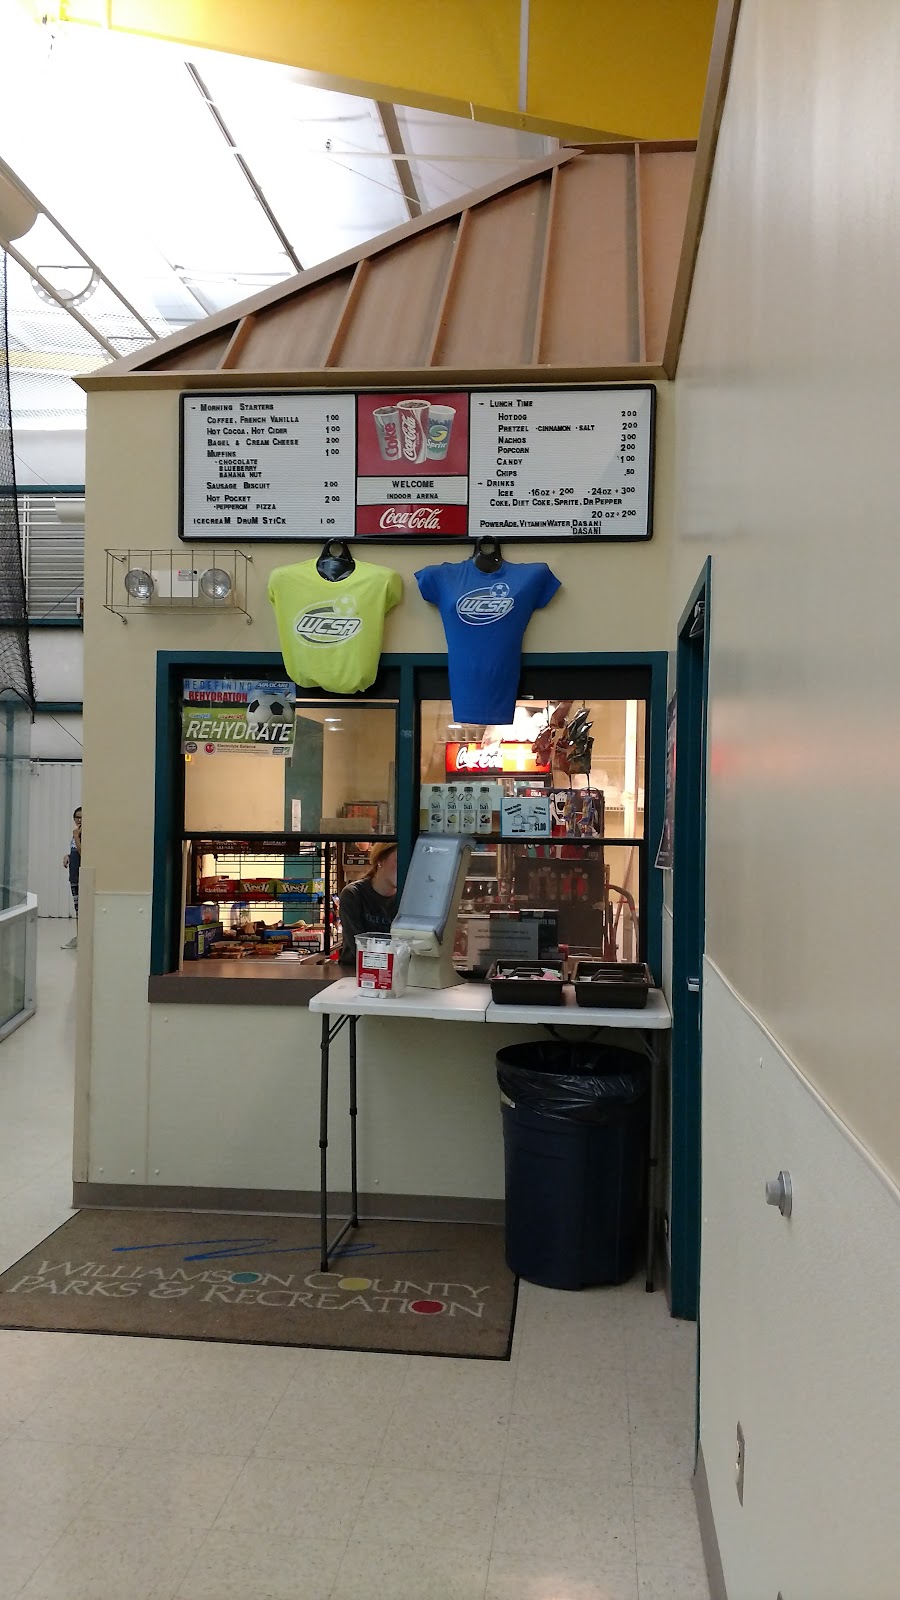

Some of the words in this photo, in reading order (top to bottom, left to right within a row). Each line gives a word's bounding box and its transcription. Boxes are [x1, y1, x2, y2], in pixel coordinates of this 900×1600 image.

[427, 439, 447, 449] Sprite
[380, 508, 443, 529] Coca-Cola
[460, 599, 513, 613] WCSA
[297, 616, 361, 636] WCSA
[185, 681, 252, 690] REDEFINING
[189, 691, 247, 701] REHYDRATION
[186, 721, 293, 741] REHYDRATE
[149, 1281, 195, 1299] &
